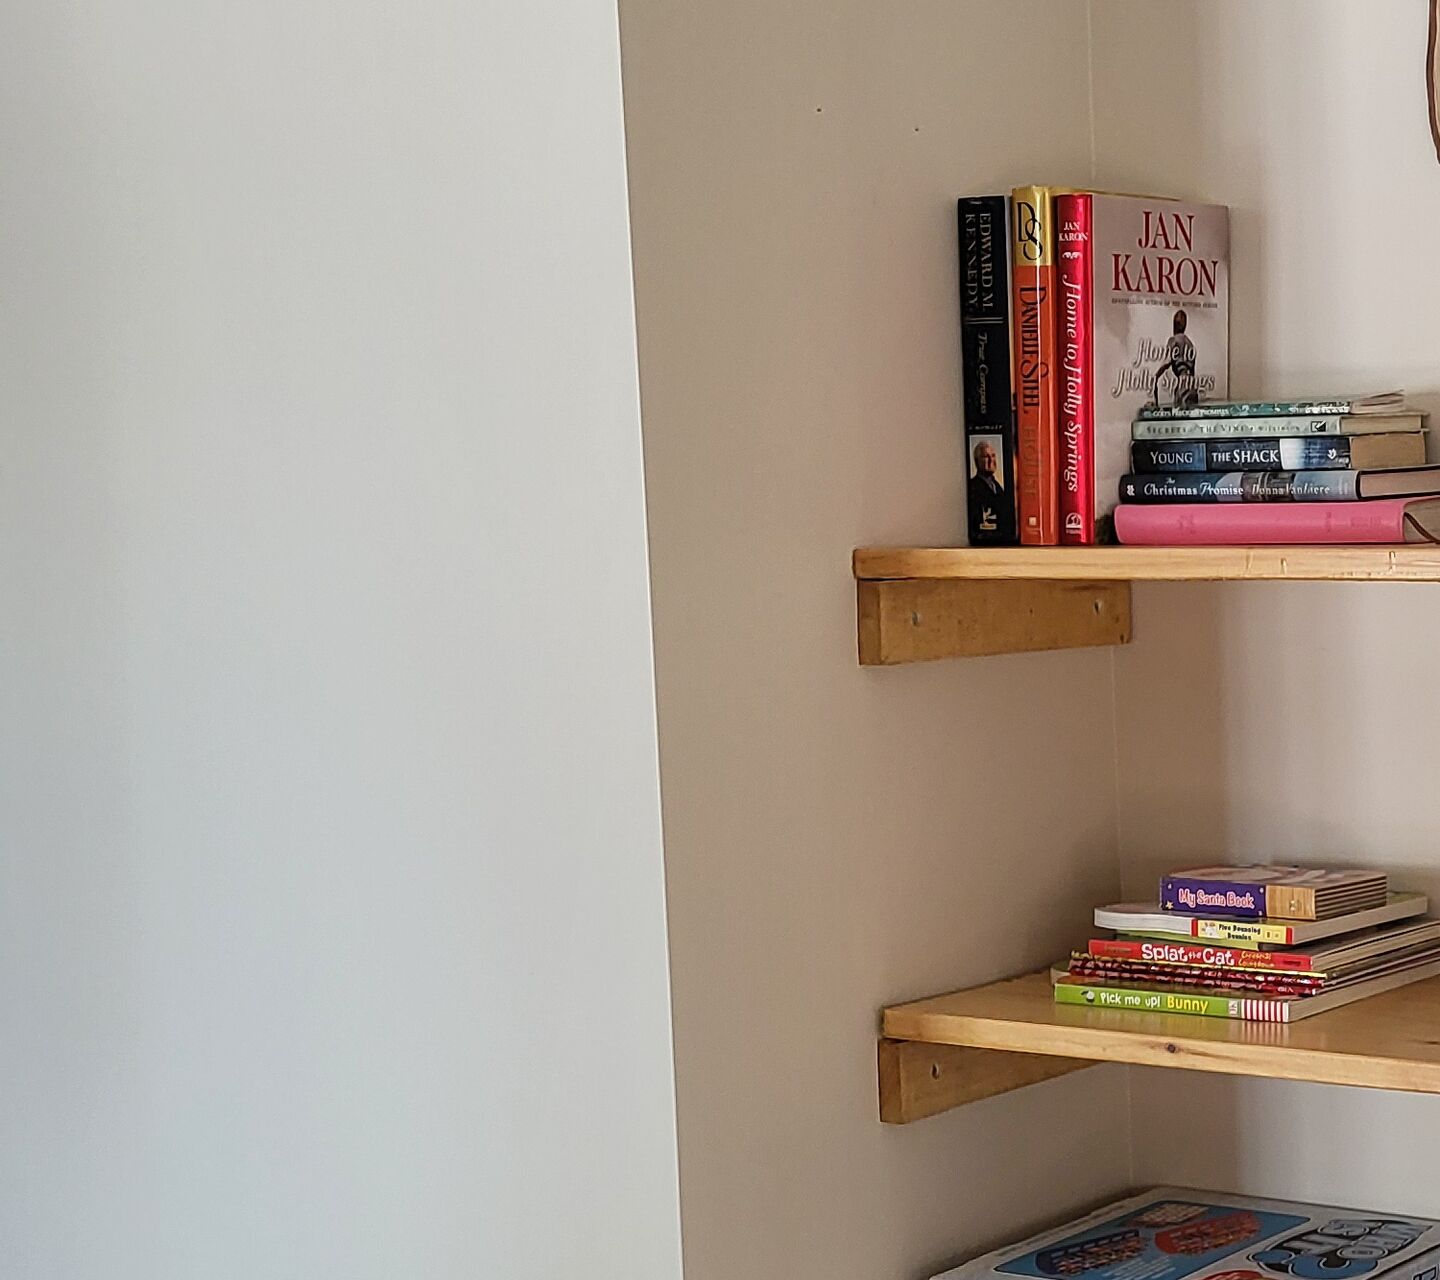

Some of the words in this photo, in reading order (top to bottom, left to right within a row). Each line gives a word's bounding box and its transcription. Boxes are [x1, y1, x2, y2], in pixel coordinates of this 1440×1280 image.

[1058, 231, 1089, 242] KARON
[1063, 221, 1080, 231] JAN
[1138, 211, 1194, 251] JAN
[965, 213, 979, 308] KENNEDY
[979, 213, 993, 287] EDWARD
[1112, 254, 1219, 297] KARON
[1062, 274, 1082, 337] Home
[1066, 342, 1080, 360] to
[1135, 339, 1179, 368] Home
[1184, 342, 1197, 362] to
[1063, 358, 1083, 417] Holly
[1113, 370, 1155, 399] Holly
[1161, 372, 1216, 399] Springs
[1063, 419, 1083, 492] Springs
[1150, 451, 1193, 465] YOUNG
[1211, 451, 1232, 462] THE
[1233, 449, 1279, 463] SHACK
[1144, 482, 1198, 496] Christmas
[1200, 482, 1244, 497] Promise
[1251, 484, 1285, 496] Donna
[1178, 888, 1196, 909] My
[1197, 889, 1226, 907] Santa
[1227, 891, 1255, 909] Book
[1141, 944, 1188, 964] Splat
[1202, 950, 1235, 965] Cat
[1124, 996, 1141, 1007] me
[1167, 995, 1209, 1014] Bunny
